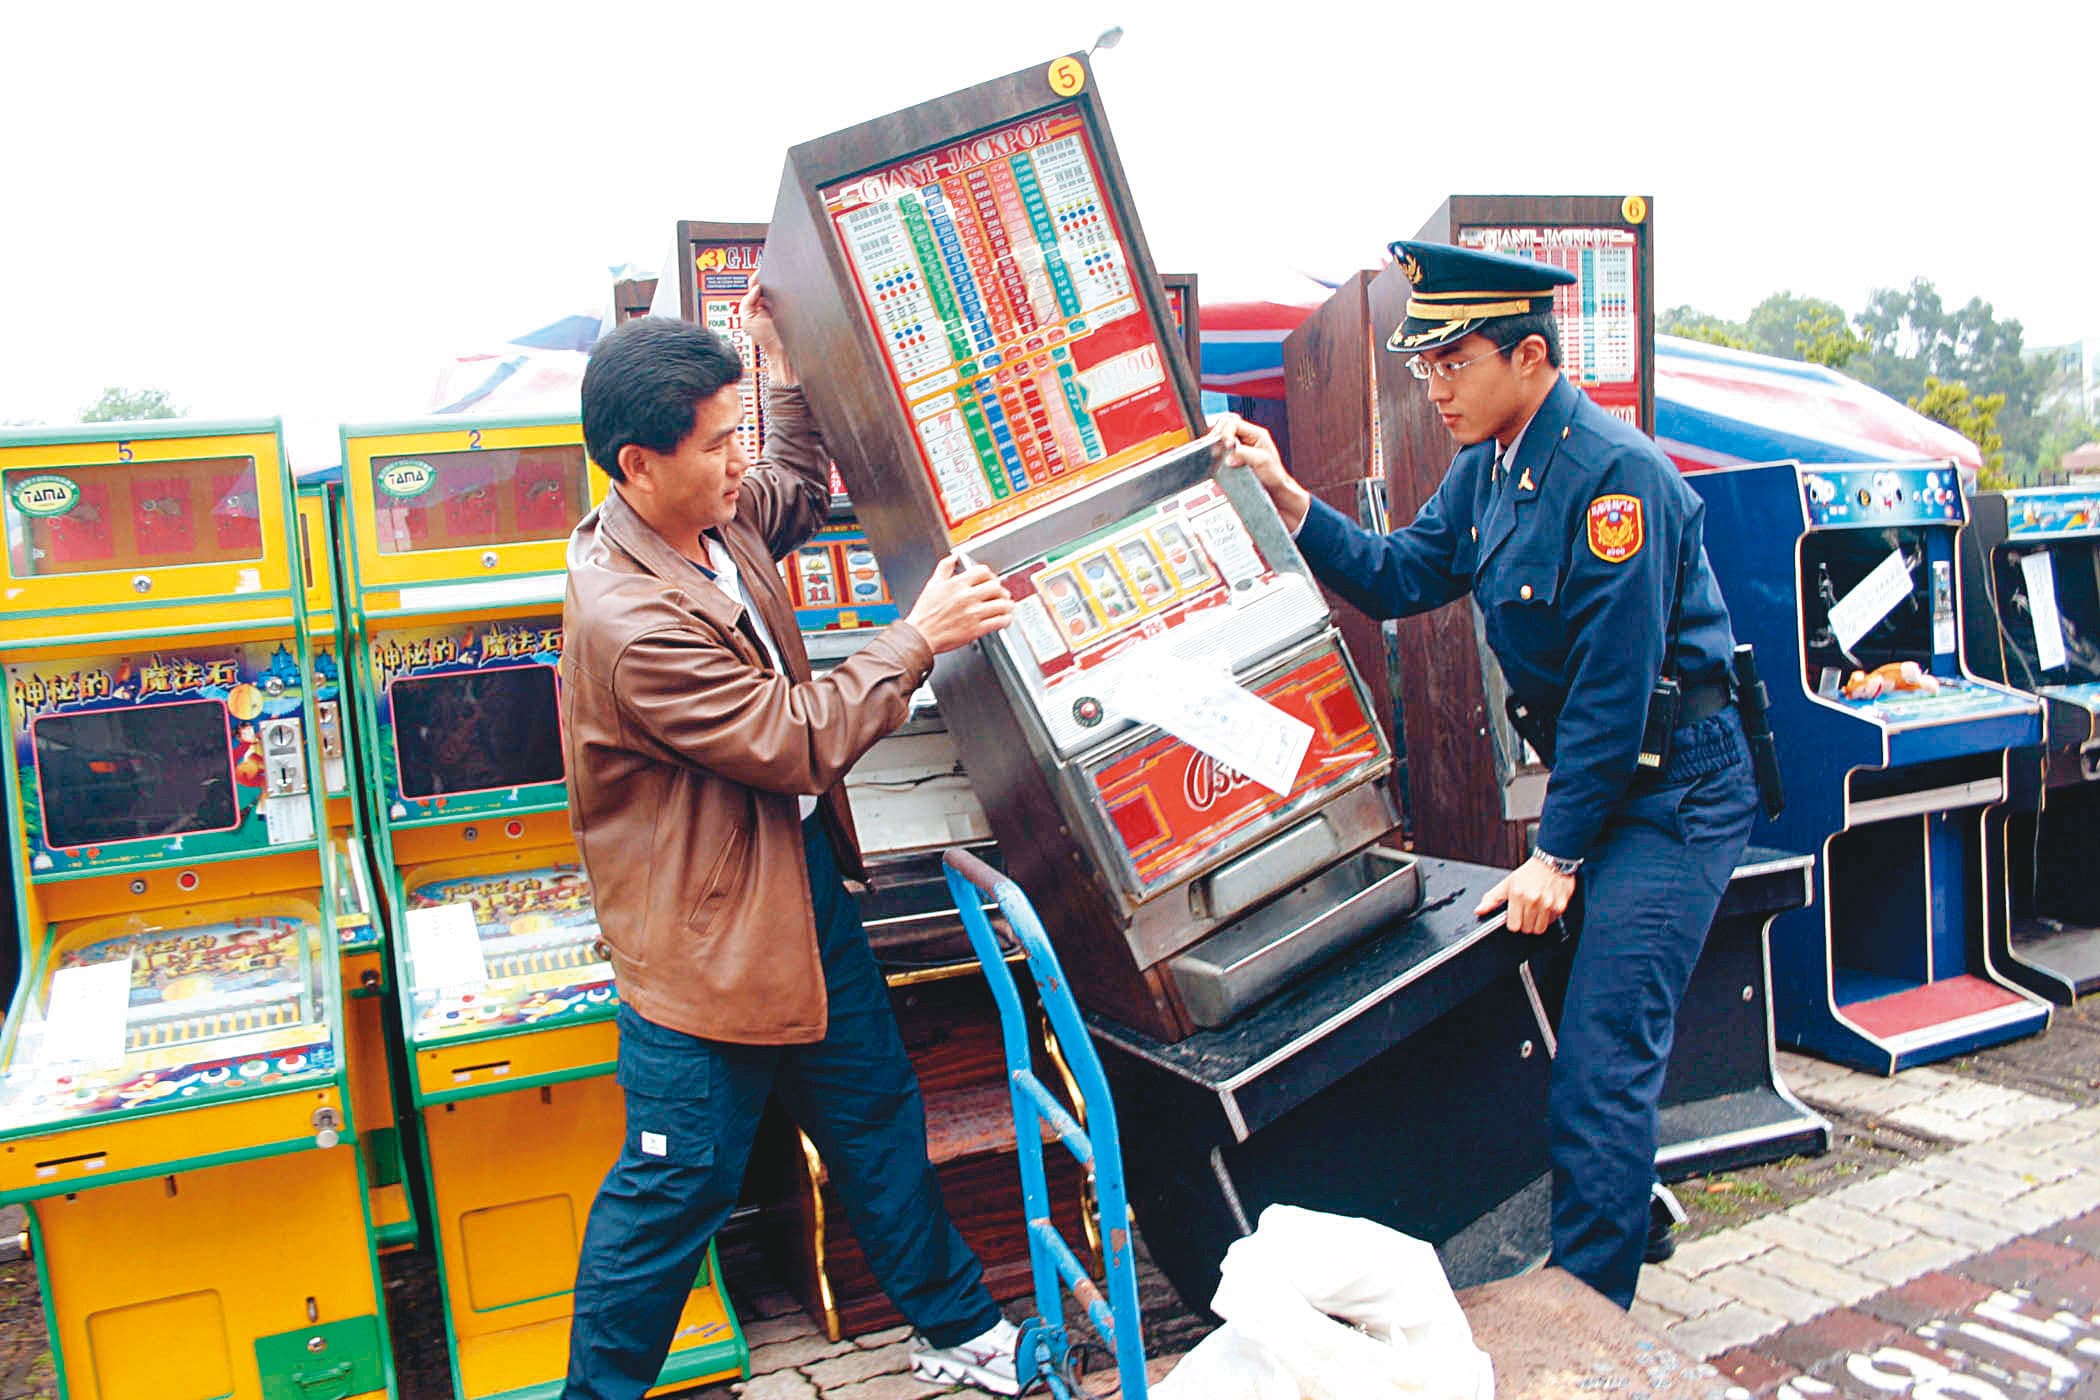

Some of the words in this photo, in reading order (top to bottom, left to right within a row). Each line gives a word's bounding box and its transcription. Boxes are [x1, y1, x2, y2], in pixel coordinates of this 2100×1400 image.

[1057, 64, 1076, 89] 5
[948, 119, 1052, 175] JACKPOT
[1629, 200, 1640, 217] 6
[704, 248, 719, 268] 3
[728, 316, 744, 330] 11
[468, 428, 483, 450] 2
[117, 439, 134, 464] 5
[389, 470, 425, 485] TAMA
[23, 487, 67, 503] TAMA
